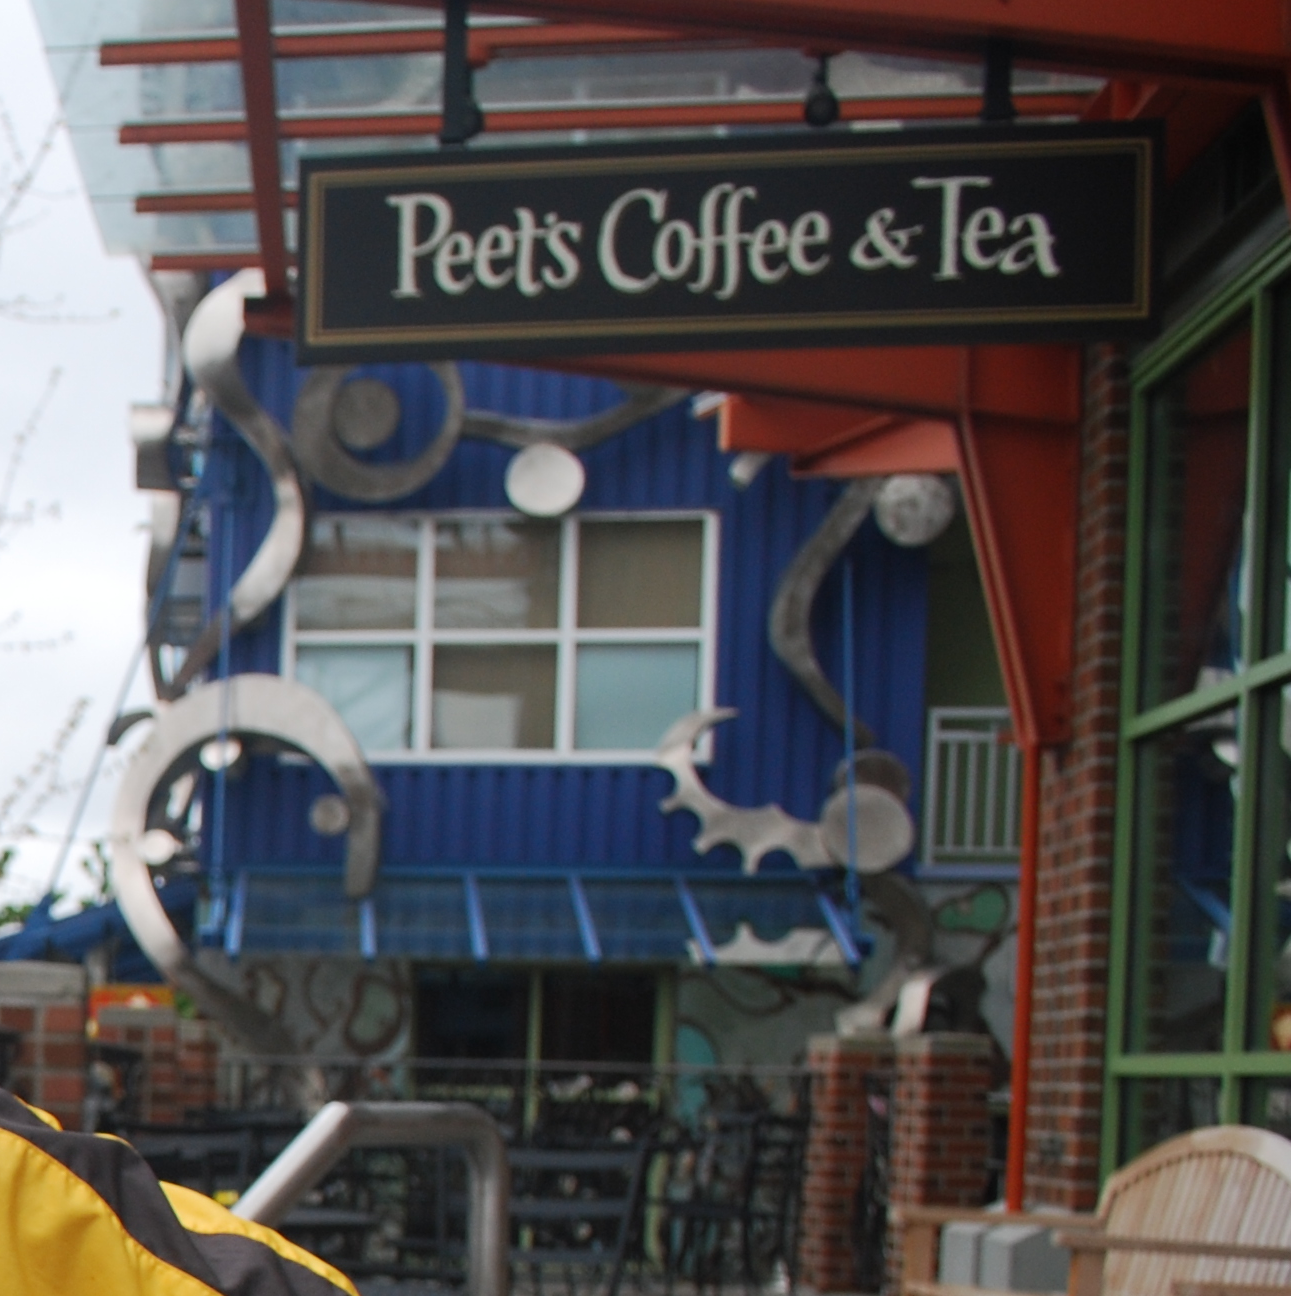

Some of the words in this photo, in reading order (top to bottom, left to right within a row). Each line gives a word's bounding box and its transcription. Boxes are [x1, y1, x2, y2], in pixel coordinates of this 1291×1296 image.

[385, 189, 583, 300] Peet's
[597, 182, 832, 300] Coffee
[849, 206, 923, 272] &
[911, 174, 1062, 282] Tea
